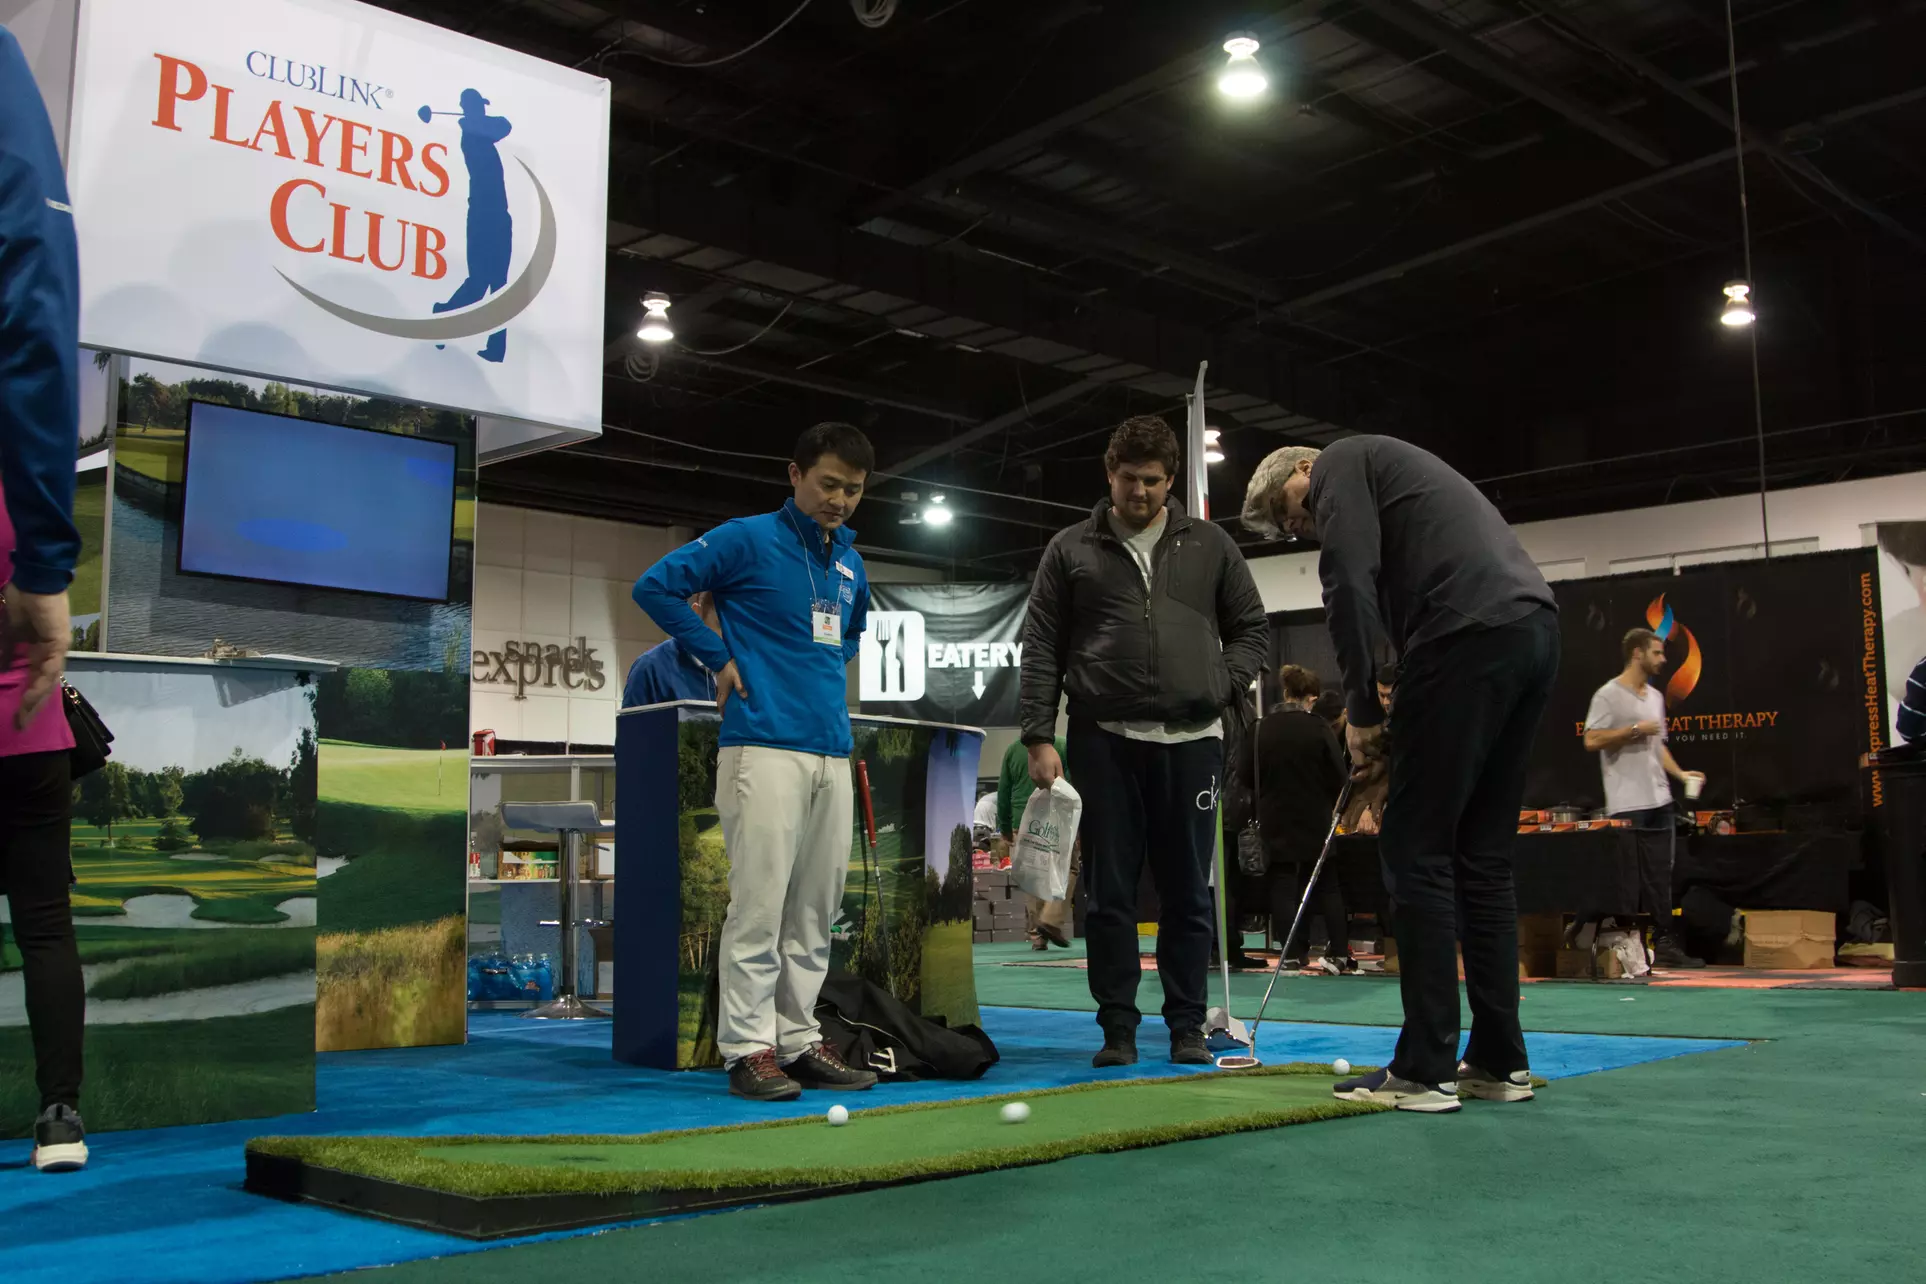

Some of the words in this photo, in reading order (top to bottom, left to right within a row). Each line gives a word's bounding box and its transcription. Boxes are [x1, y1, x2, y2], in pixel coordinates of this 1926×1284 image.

[151, 52, 450, 198] PLAYERS
[269, 178, 448, 280] CLUB
[927, 641, 1023, 669] EATERY
[1694, 711, 1779, 731] THERAPY
[1675, 734, 1696, 742] YOU
[1701, 732, 1729, 741] NEED
